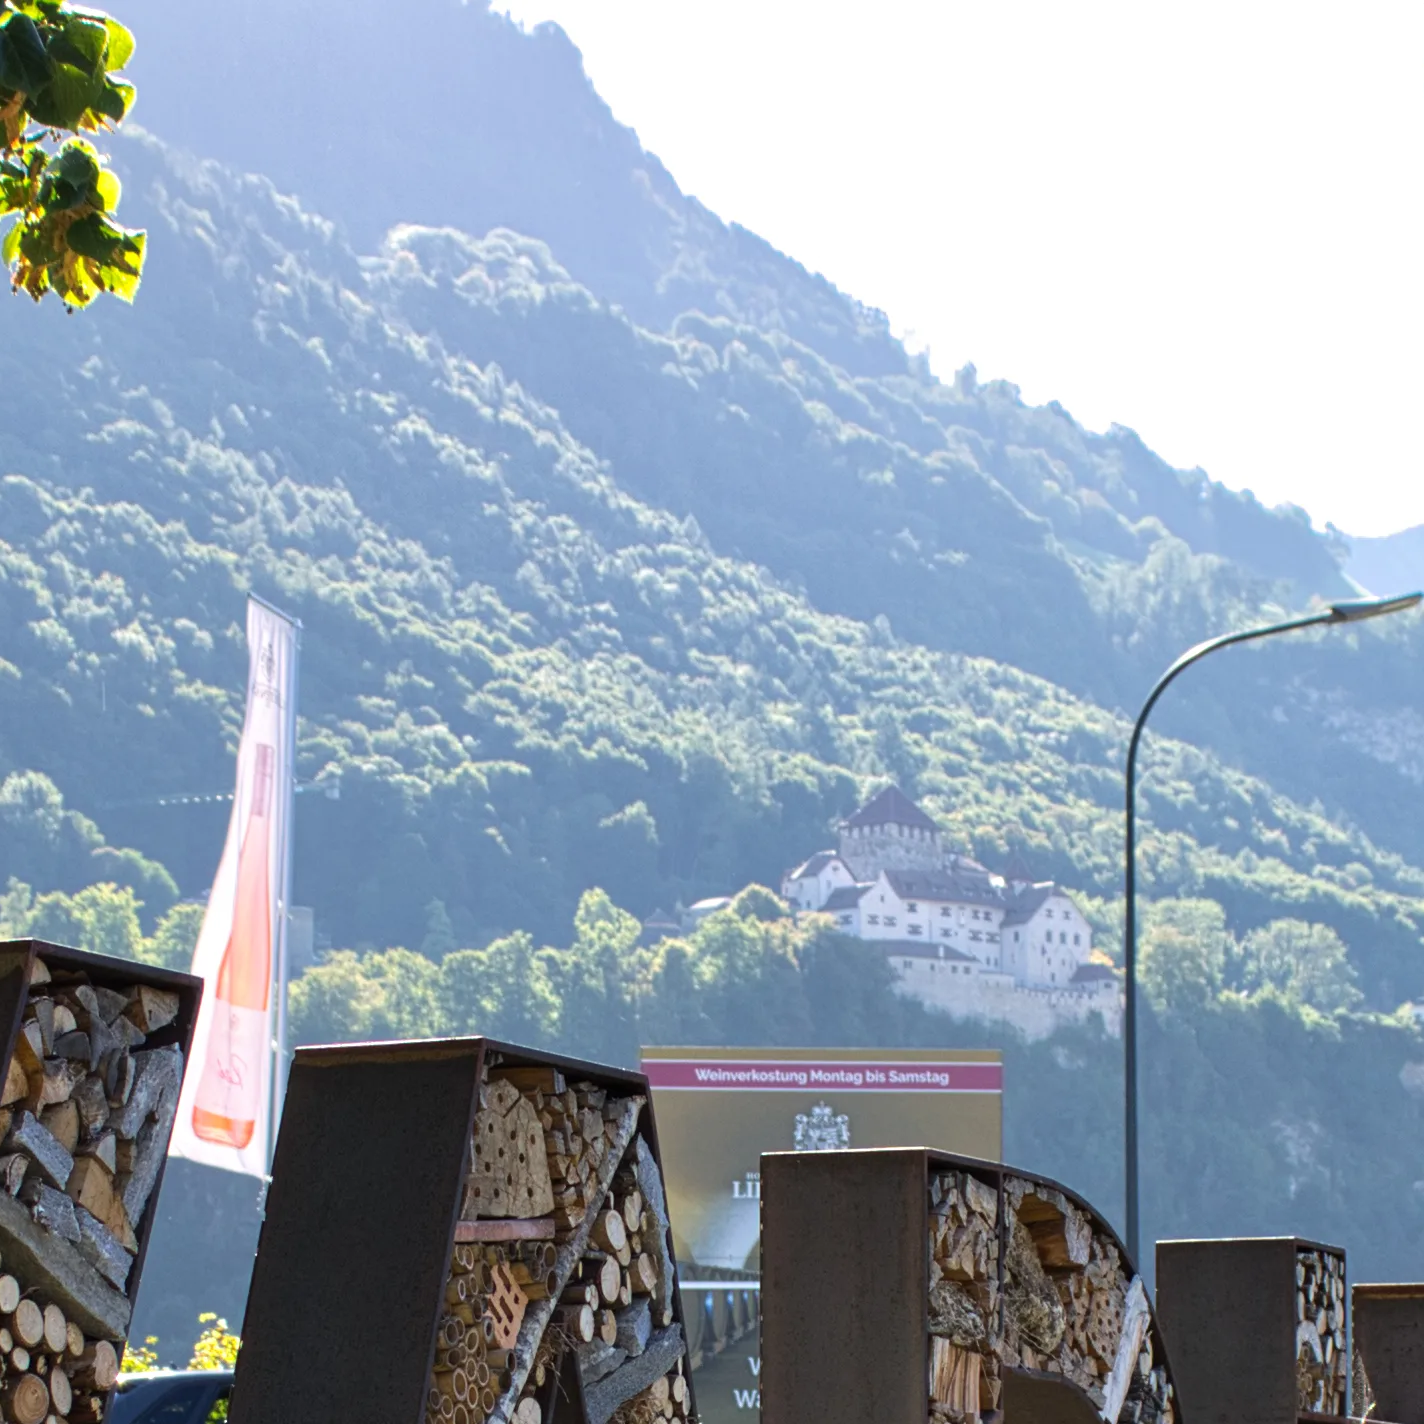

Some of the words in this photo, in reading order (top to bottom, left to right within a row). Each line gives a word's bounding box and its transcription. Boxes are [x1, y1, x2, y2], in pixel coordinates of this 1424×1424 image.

[694, 1068, 808, 1085] Weinverkostung
[810, 1069, 863, 1086] Montag
[865, 1070, 886, 1083] bis
[889, 1070, 950, 1087] Samstag
